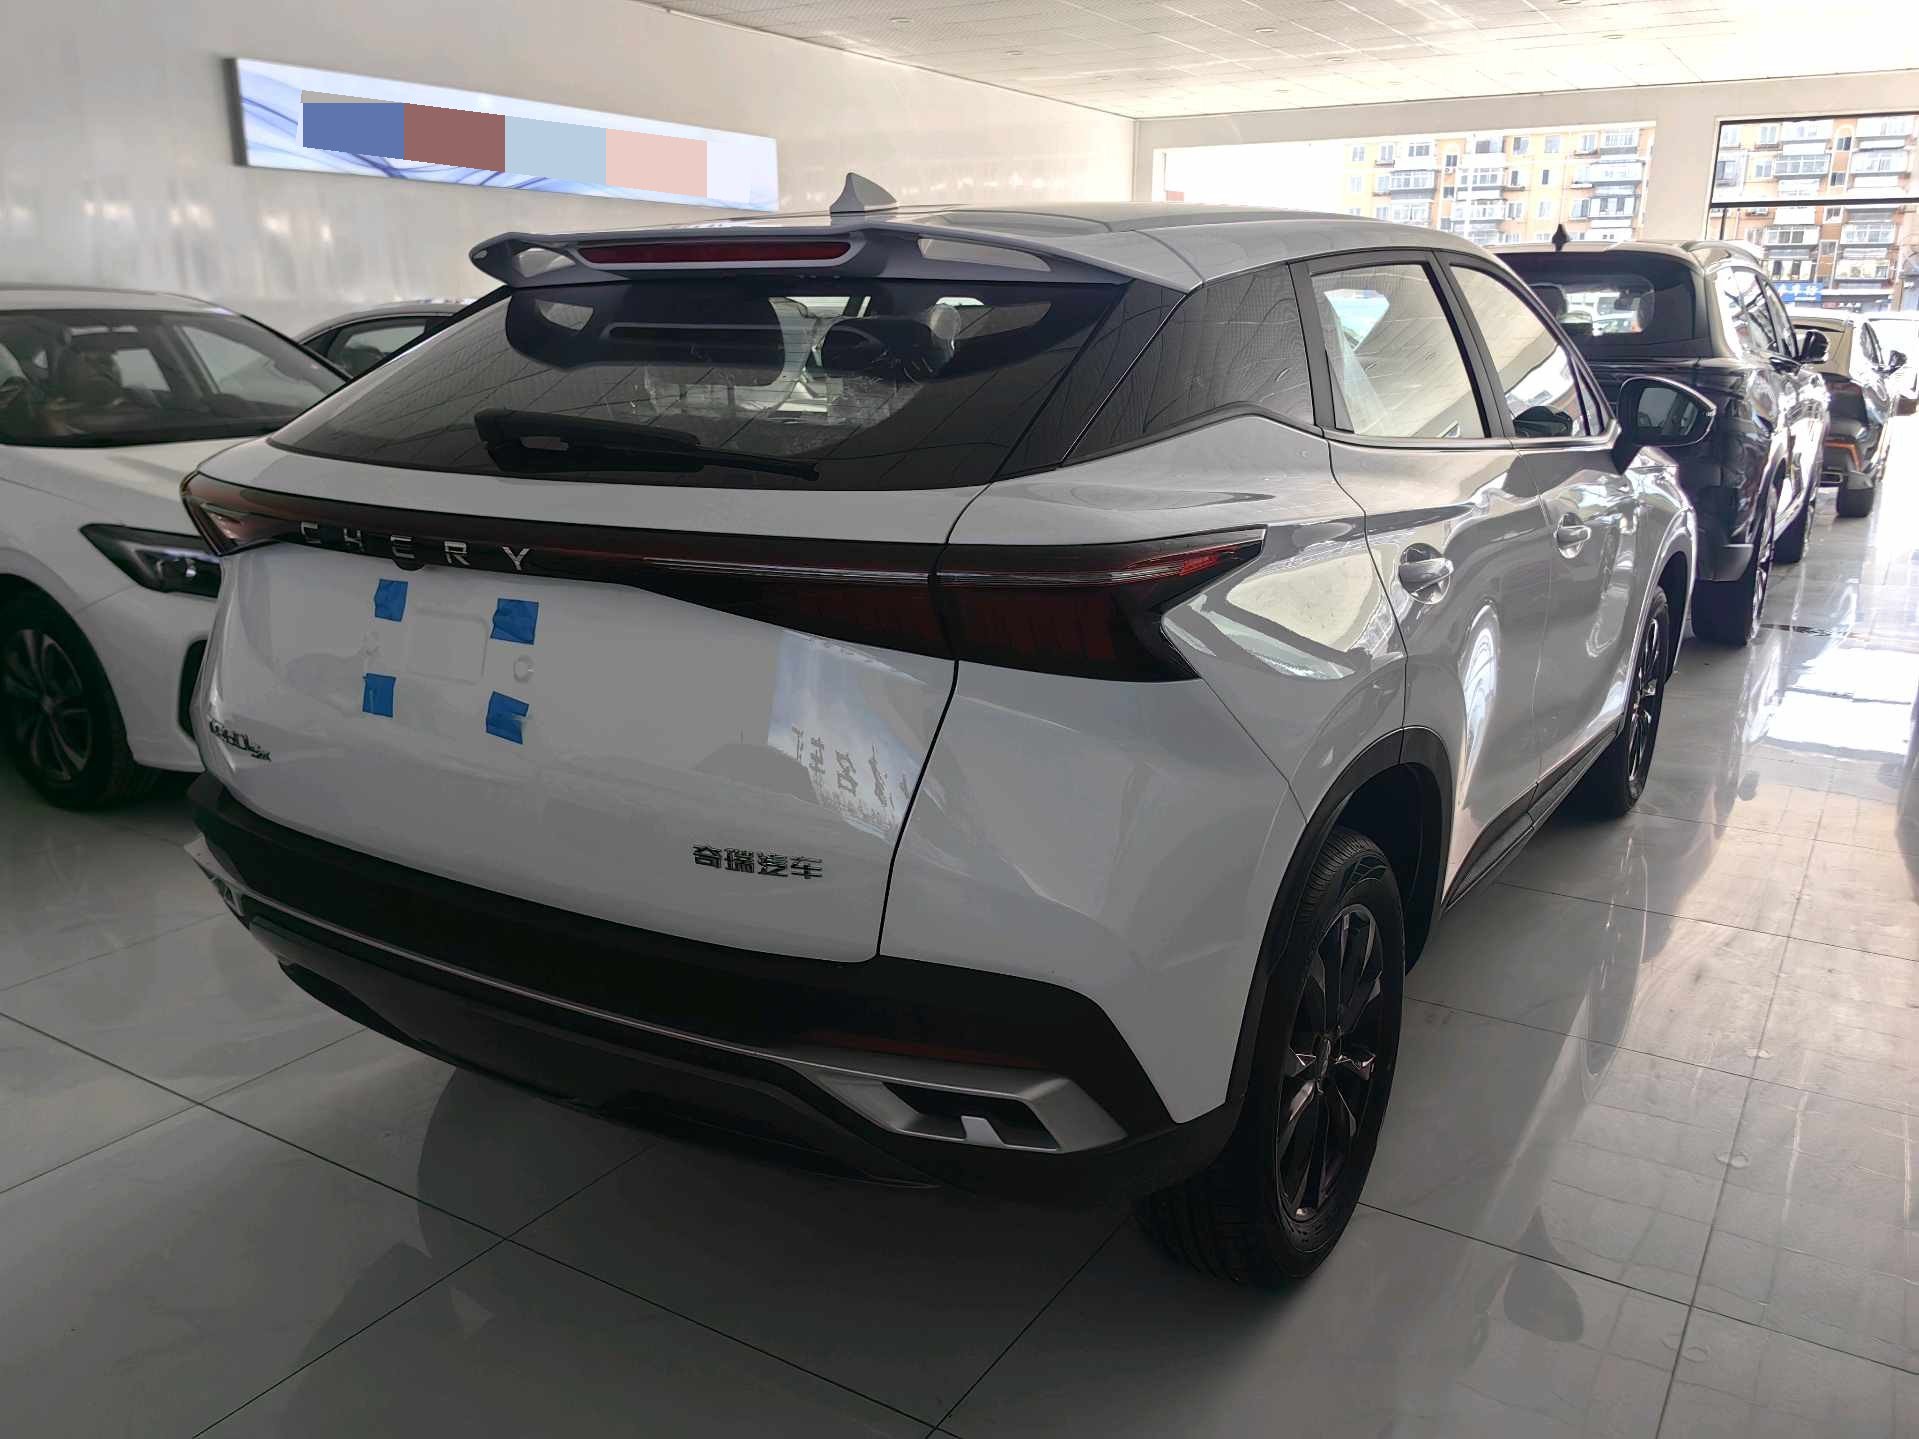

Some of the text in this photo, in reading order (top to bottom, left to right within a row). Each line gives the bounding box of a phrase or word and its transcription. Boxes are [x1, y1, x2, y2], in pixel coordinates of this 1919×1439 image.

[300, 521, 530, 571] CHERY
[692, 845, 823, 880] 奇瑞汽车
